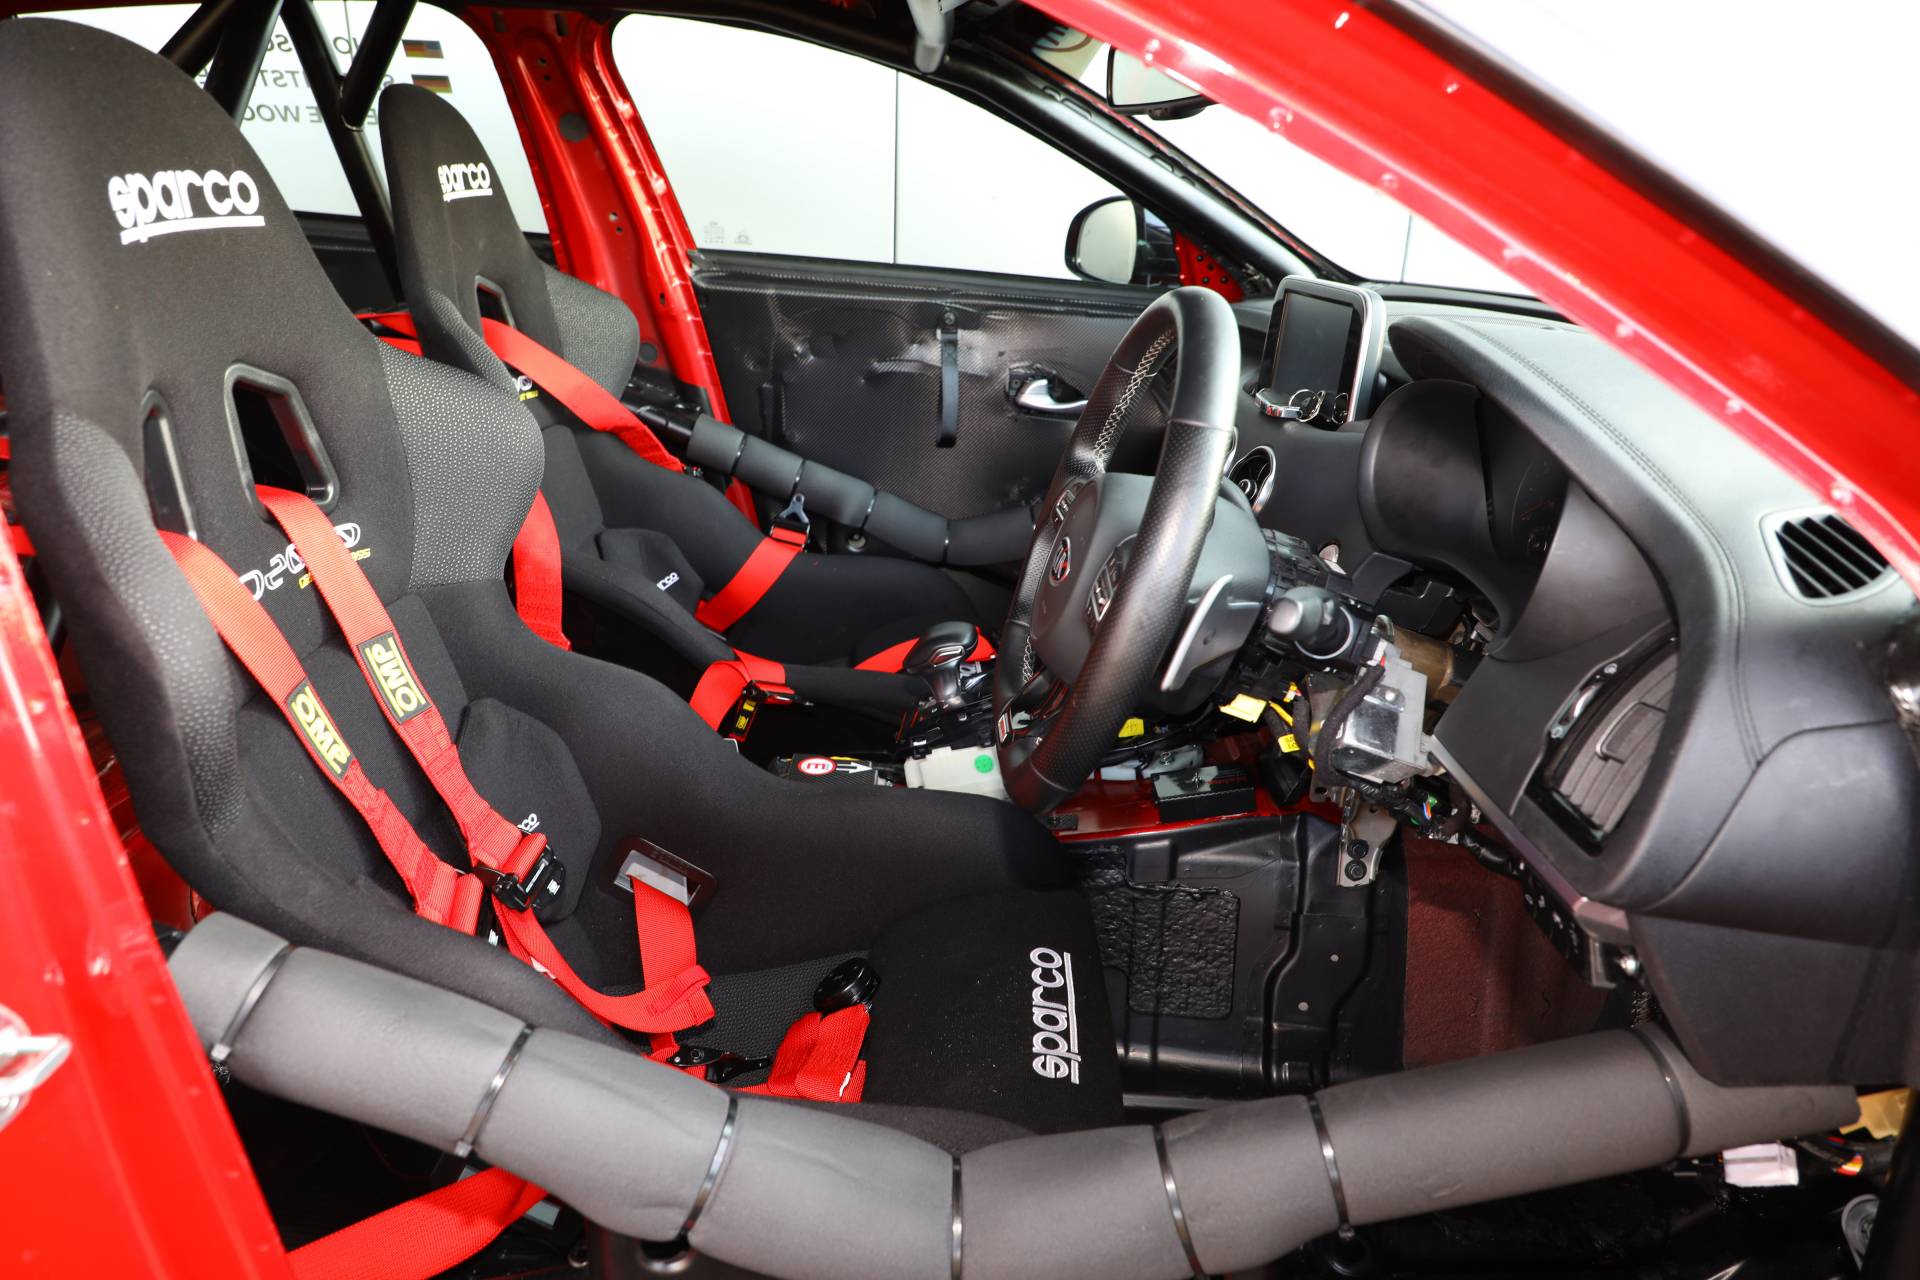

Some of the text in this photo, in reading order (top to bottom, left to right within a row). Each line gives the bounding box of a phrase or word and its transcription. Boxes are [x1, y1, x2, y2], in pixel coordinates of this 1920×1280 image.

[108, 169, 266, 245] sparco
[437, 162, 493, 203] sparco
[370, 637, 427, 717] OMP
[291, 685, 351, 774] OMP
[1029, 947, 1082, 1085] sparco
